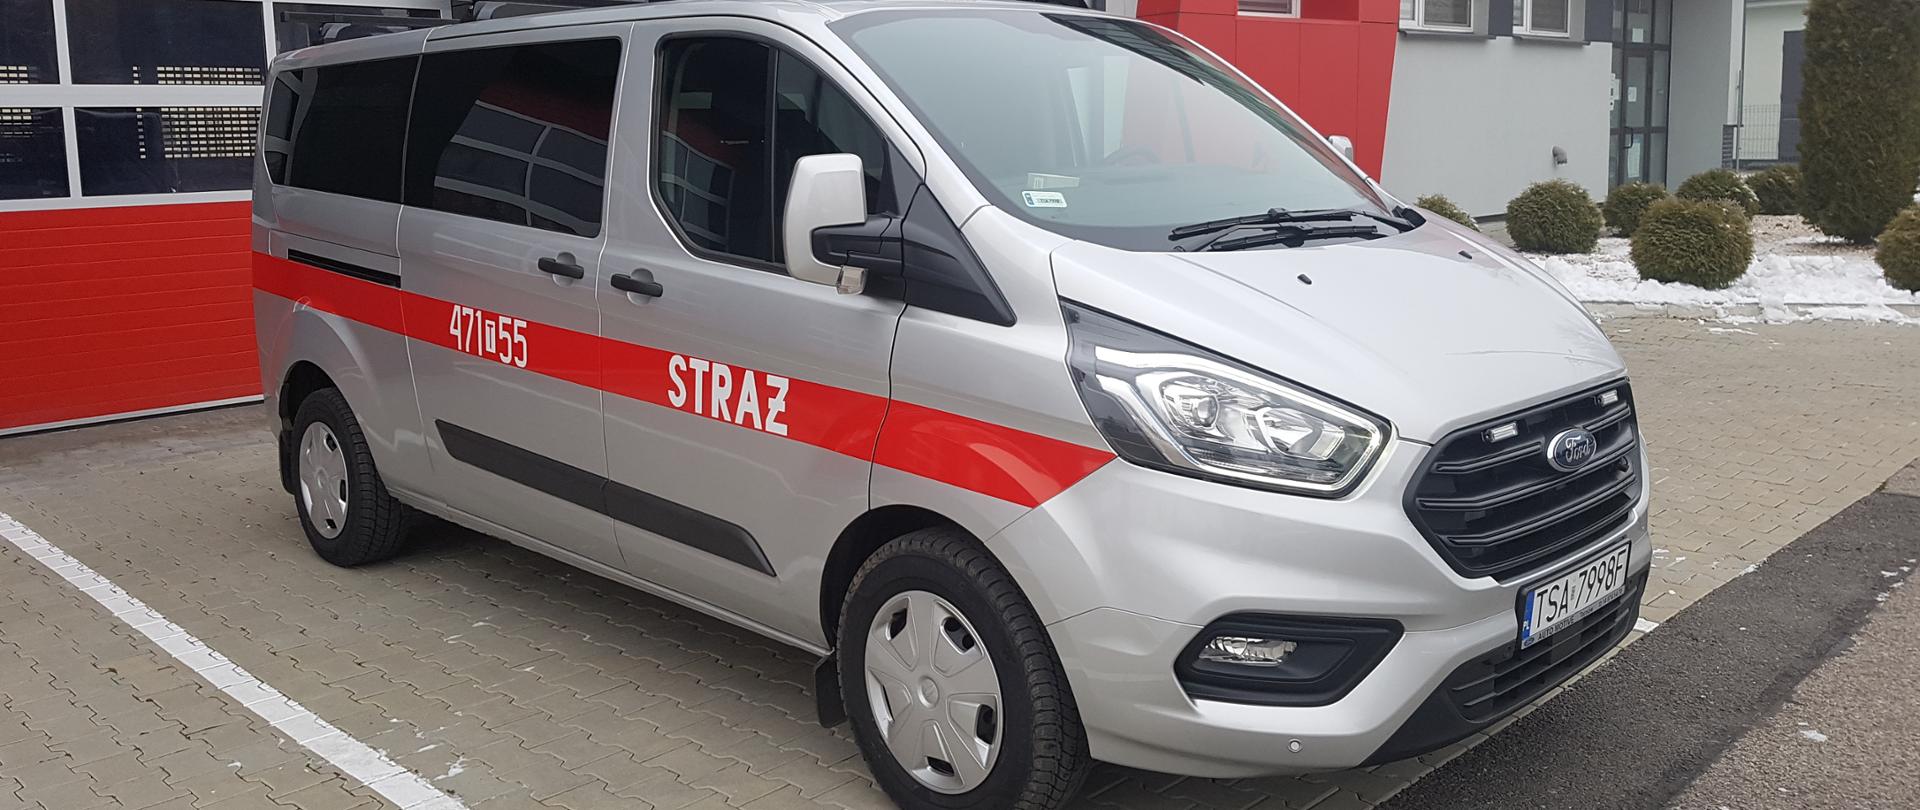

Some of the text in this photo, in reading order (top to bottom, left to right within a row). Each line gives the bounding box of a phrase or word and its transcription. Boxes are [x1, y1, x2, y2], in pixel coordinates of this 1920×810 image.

[667, 354, 789, 437] STRAŻ
[1565, 435, 1593, 463] Ford
[1536, 548, 1627, 628] TSA 7998F
[1537, 627, 1554, 641] AUTO
